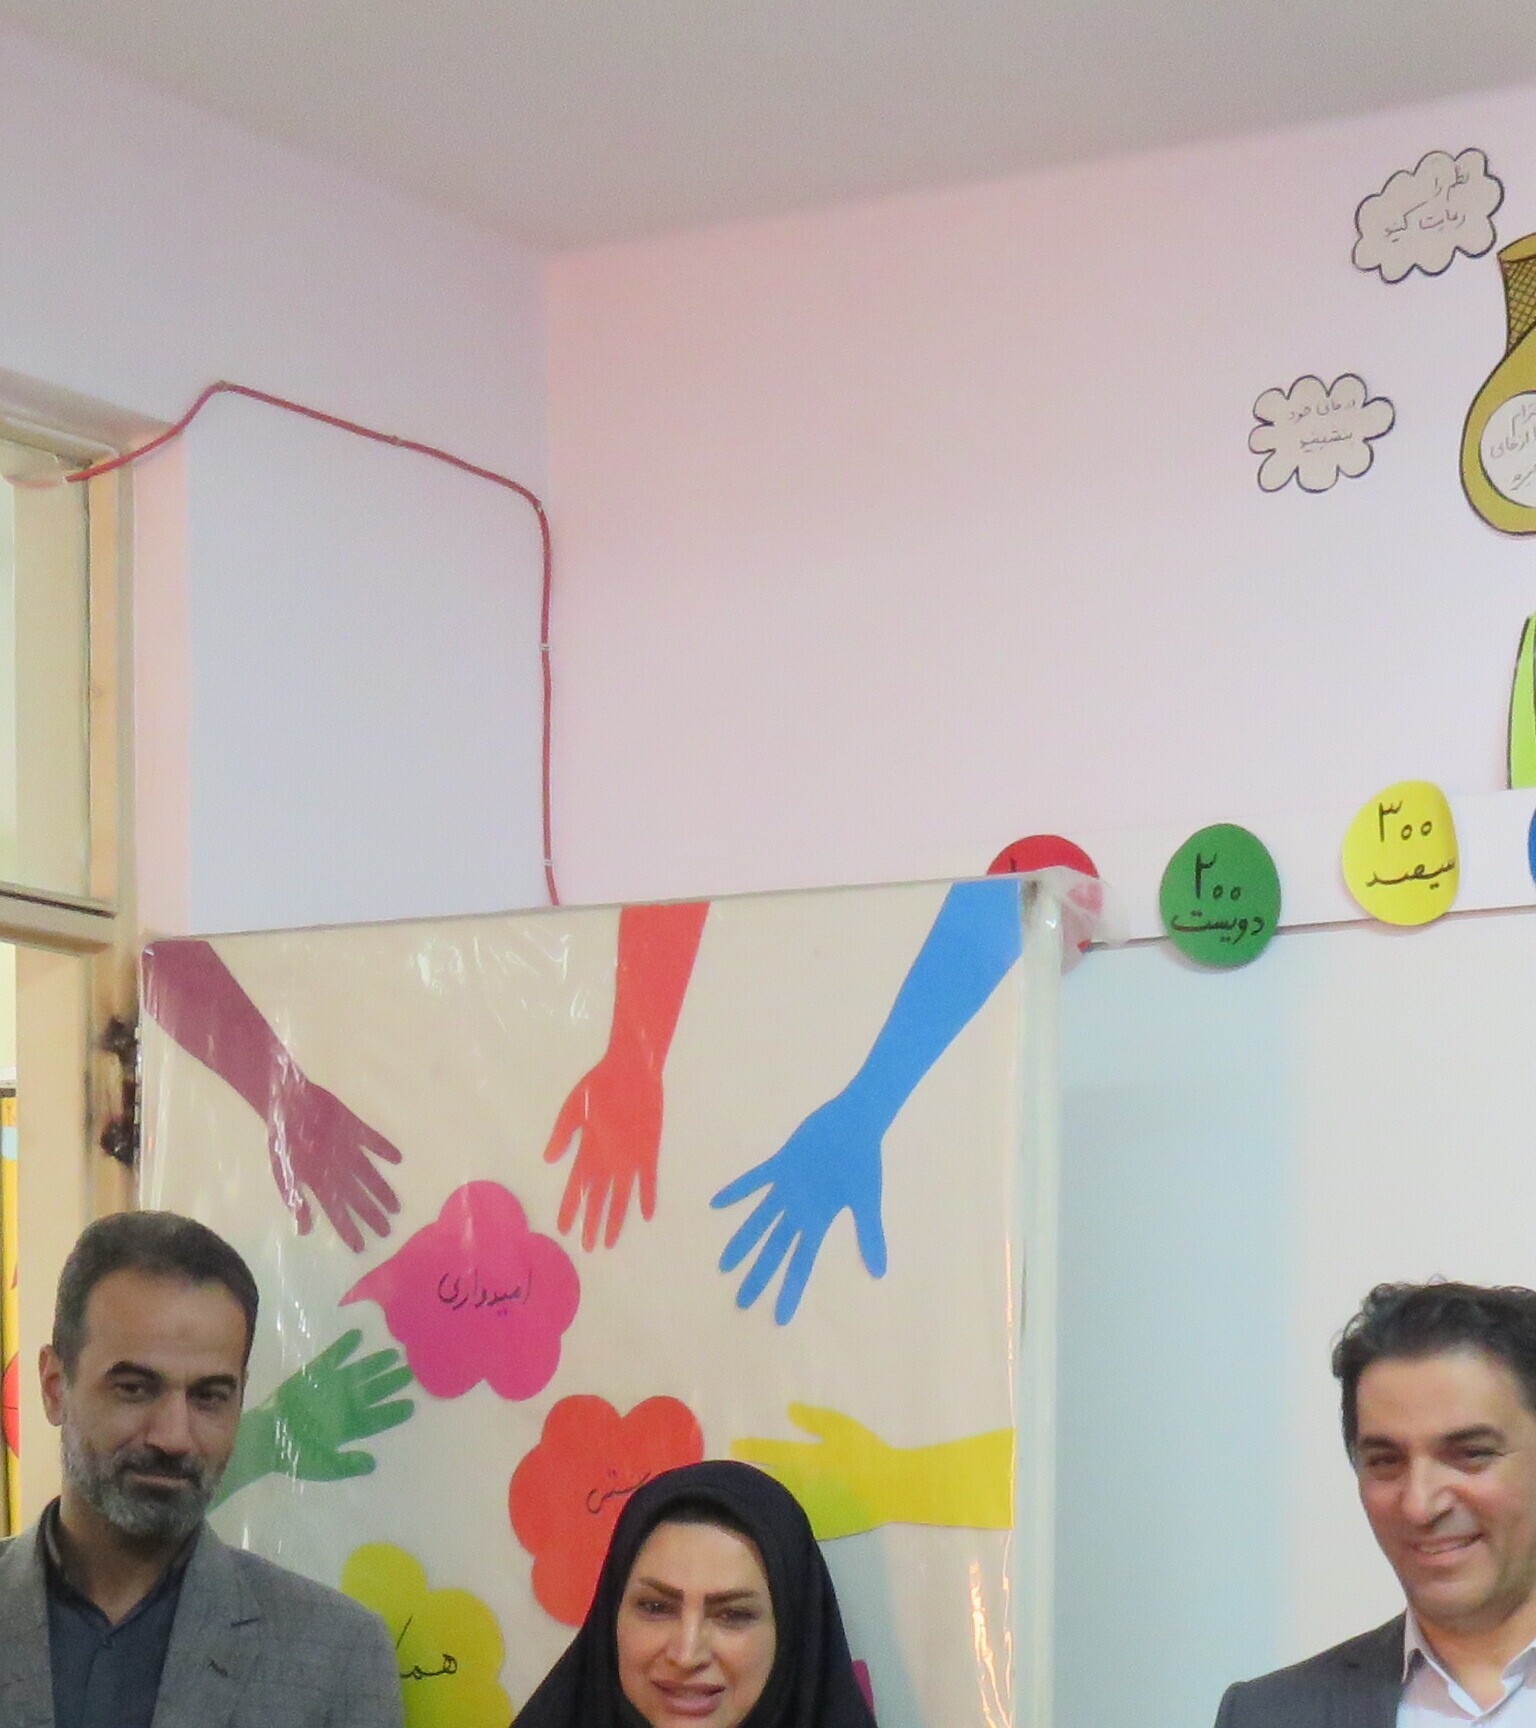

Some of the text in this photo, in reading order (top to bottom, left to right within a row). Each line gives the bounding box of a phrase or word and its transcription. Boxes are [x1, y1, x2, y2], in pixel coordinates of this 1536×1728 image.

[1377, 799, 1434, 843] ۳۰۰
[1194, 852, 1243, 901] ۲۰۰
[1365, 857, 1457, 890] سیصد
[1170, 910, 1266, 945] دویست
[437, 1267, 531, 1318] امیدواری
